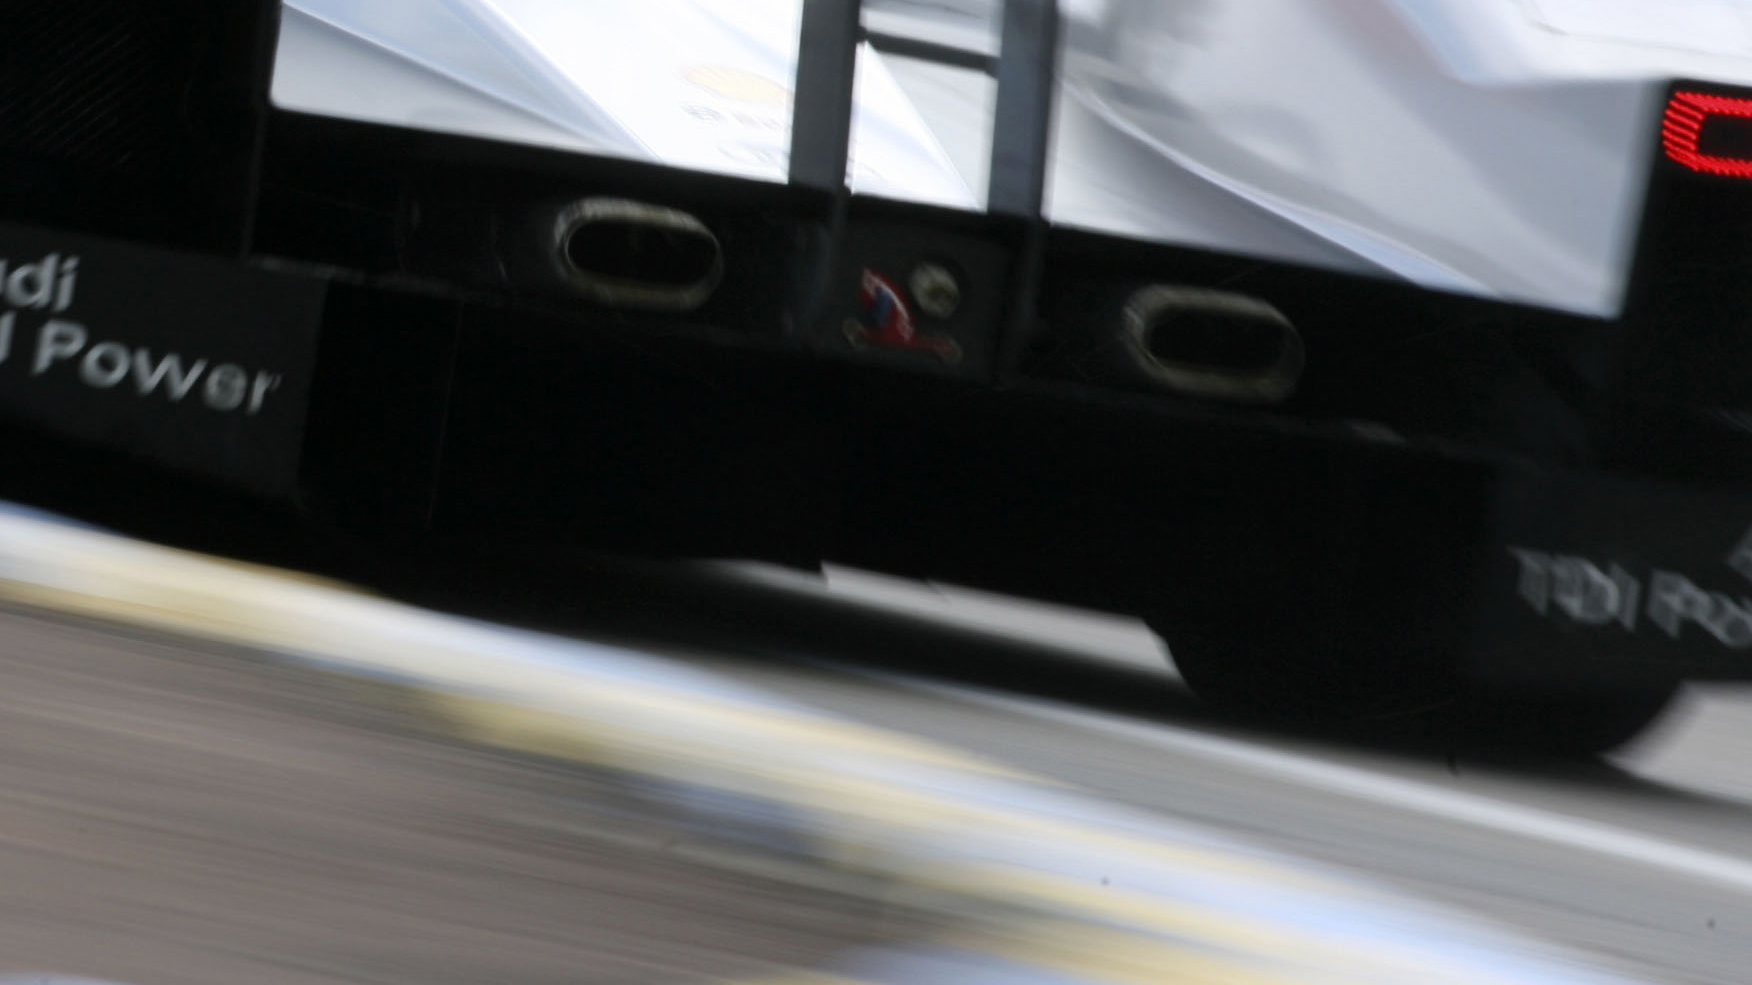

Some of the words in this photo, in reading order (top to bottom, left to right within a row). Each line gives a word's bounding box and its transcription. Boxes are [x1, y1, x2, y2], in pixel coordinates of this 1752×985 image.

[30, 318, 283, 414] Power
[1506, 546, 1640, 634] TDI
[1647, 567, 1752, 649] Po
